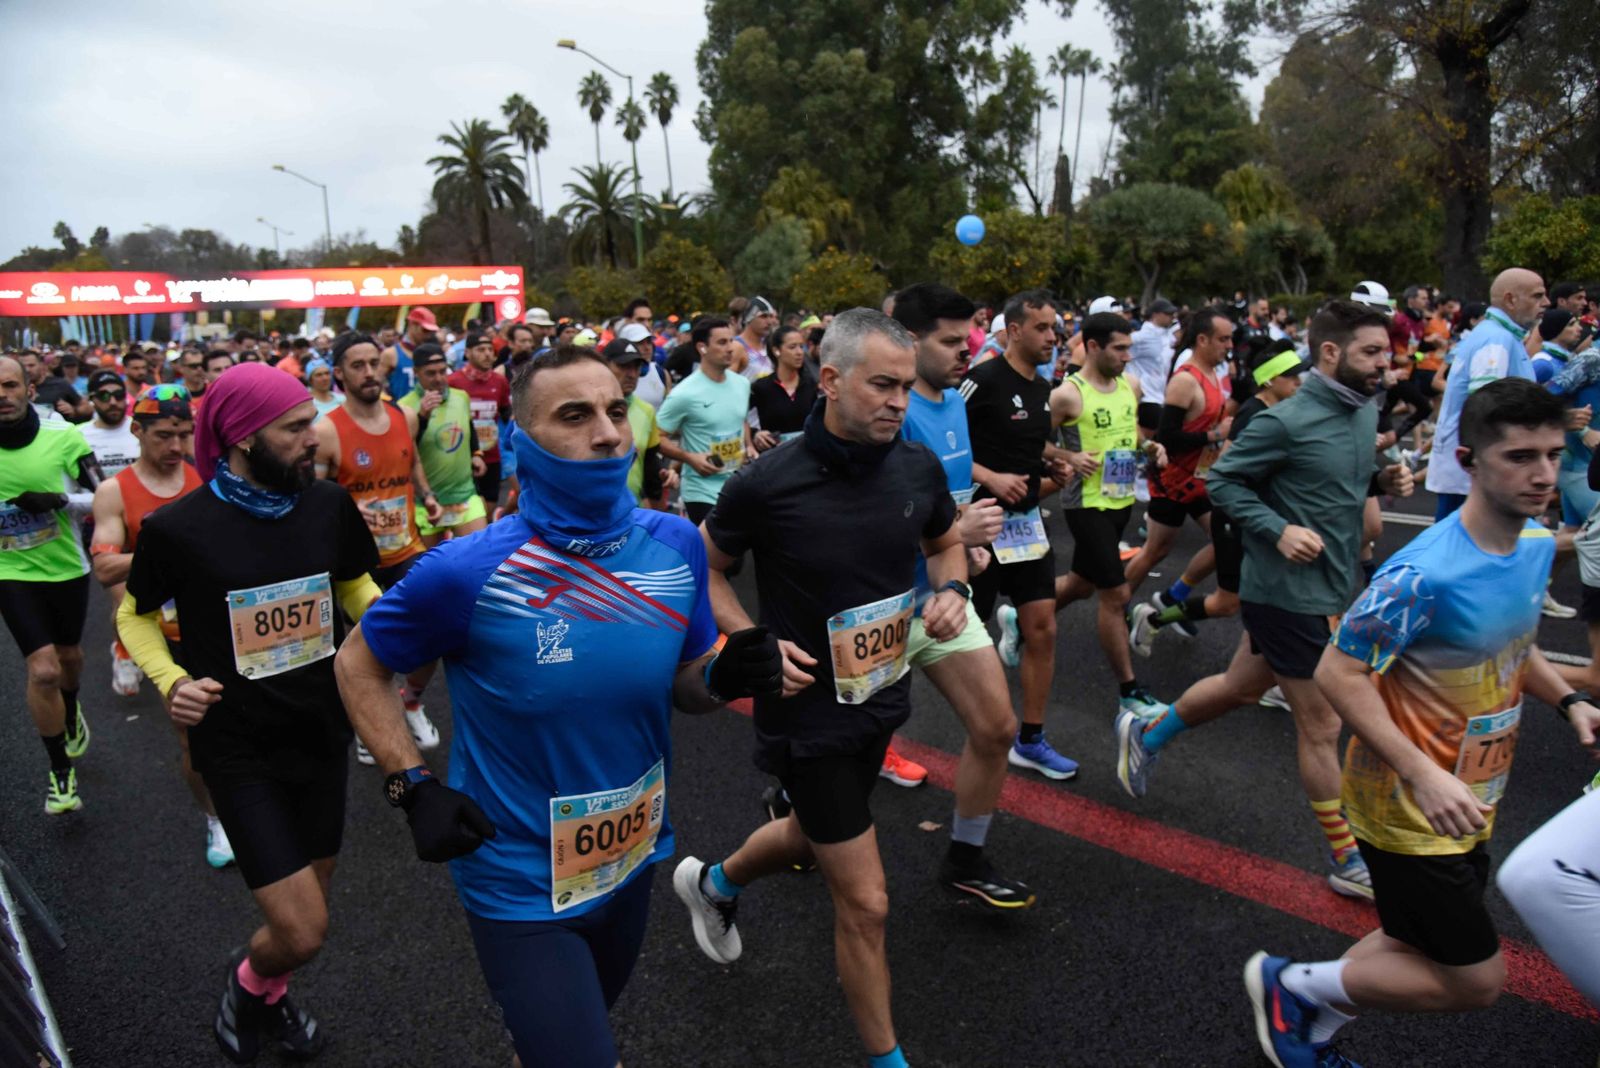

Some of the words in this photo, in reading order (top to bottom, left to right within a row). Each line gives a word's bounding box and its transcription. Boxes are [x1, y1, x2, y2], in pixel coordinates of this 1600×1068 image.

[254, 599, 317, 637] 8057
[854, 618, 905, 660] 8200
[574, 801, 647, 857] 6005
